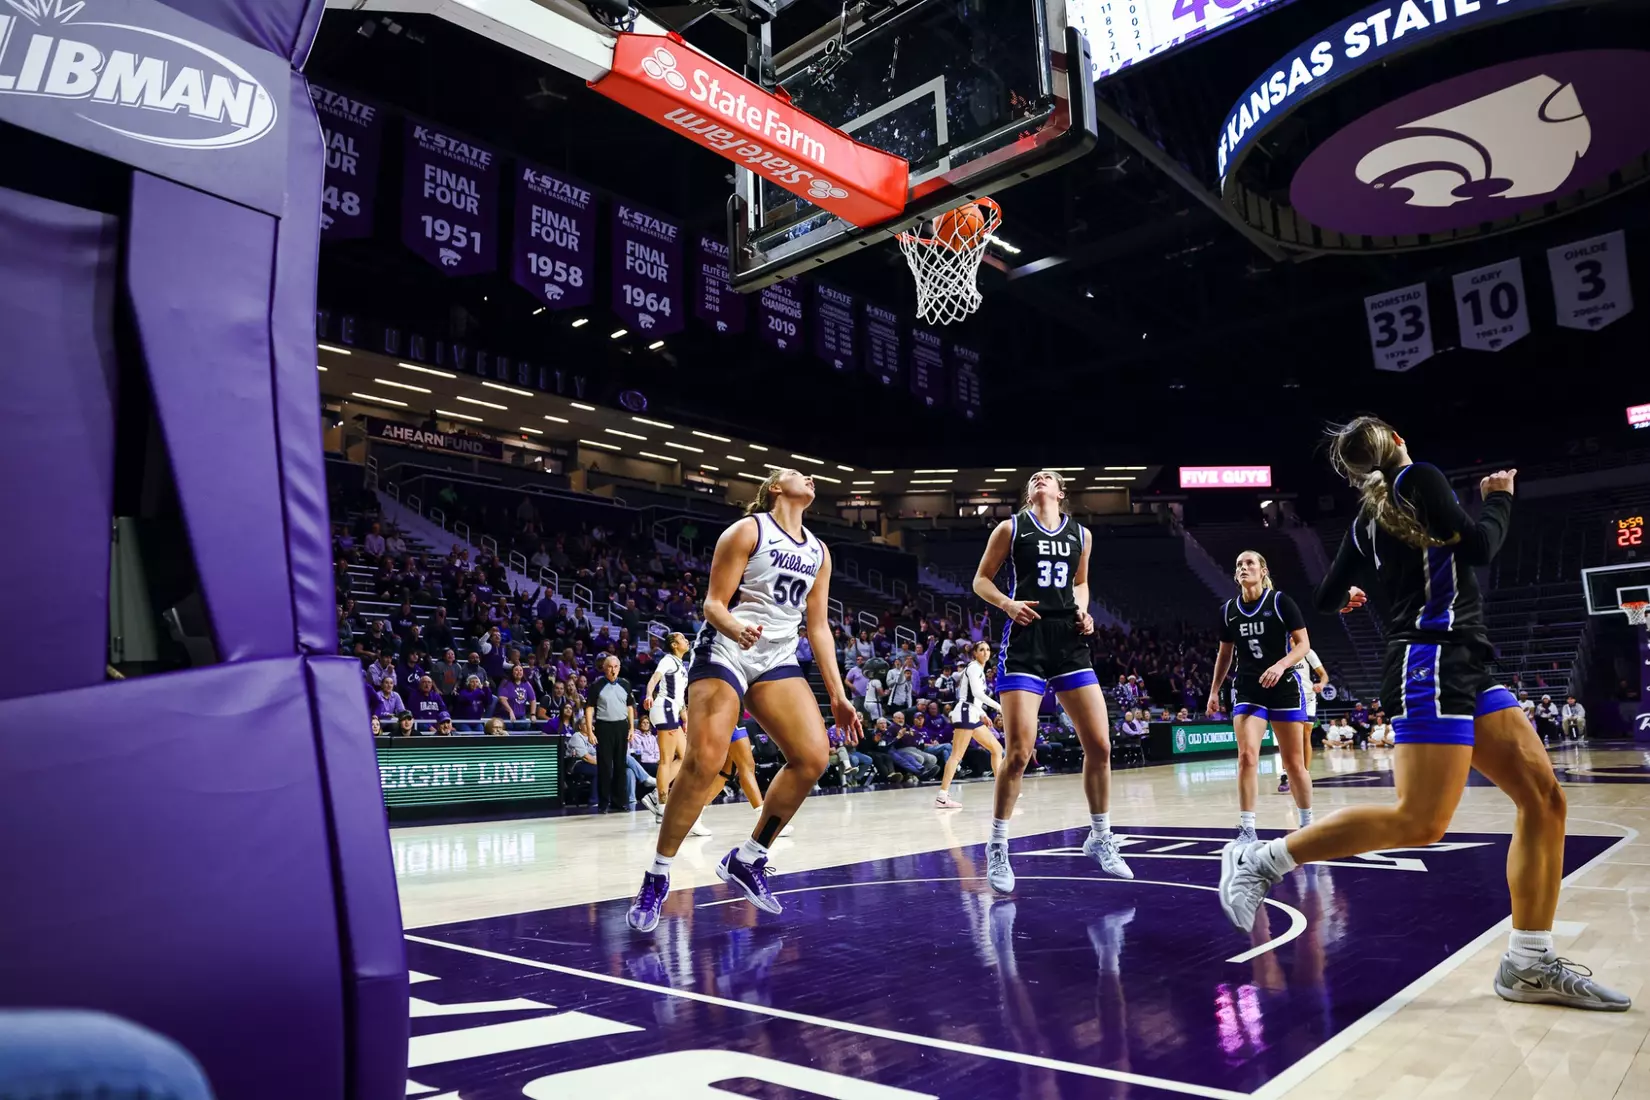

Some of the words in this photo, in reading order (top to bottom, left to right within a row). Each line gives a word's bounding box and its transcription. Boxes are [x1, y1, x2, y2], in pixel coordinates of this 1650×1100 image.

[1105, 16, 1112, 26] 8
[1108, 28, 1115, 39] 5
[1134, 29, 1141, 39] 2
[0, 14, 257, 129] LIBMAN
[1109, 52, 1121, 63] 11
[1227, 41, 1334, 153] KANSAS
[413, 125, 492, 167] K-STATE
[424, 163, 481, 199] FINAL
[523, 167, 591, 205] K-STATE
[423, 181, 479, 216] FOUR
[531, 204, 581, 237] FINAL
[618, 205, 678, 239] K-STATE
[420, 215, 481, 255] 1951
[530, 221, 580, 253] FOUR
[626, 239, 669, 269] FINAL
[527, 252, 584, 287] 1958
[625, 255, 668, 284] FOUR
[702, 263, 721, 277] ELITE
[1471, 269, 1502, 285] GARY
[1574, 260, 1606, 301] 3
[622, 284, 672, 318] 1964
[761, 296, 803, 320] CHAMPIONS
[818, 284, 853, 306] K-STATE
[1370, 290, 1421, 311] ROMSTAD
[1462, 281, 1518, 326] 10
[768, 315, 797, 337] 2019
[1373, 304, 1425, 349] 33
[1181, 470, 1219, 485] FIVE
[1222, 469, 1269, 484] GUYS
[1617, 527, 1642, 546] 22
[1618, 516, 1644, 529] 6:59
[1037, 540, 1071, 557] EIU
[1037, 560, 1069, 588] 33
[773, 574, 808, 608] 50
[1239, 621, 1265, 637] EIU
[1248, 639, 1263, 659] 5
[1188, 733, 1202, 745] OLD
[378, 764, 468, 789] EIGHT
[478, 761, 536, 784] LINE
